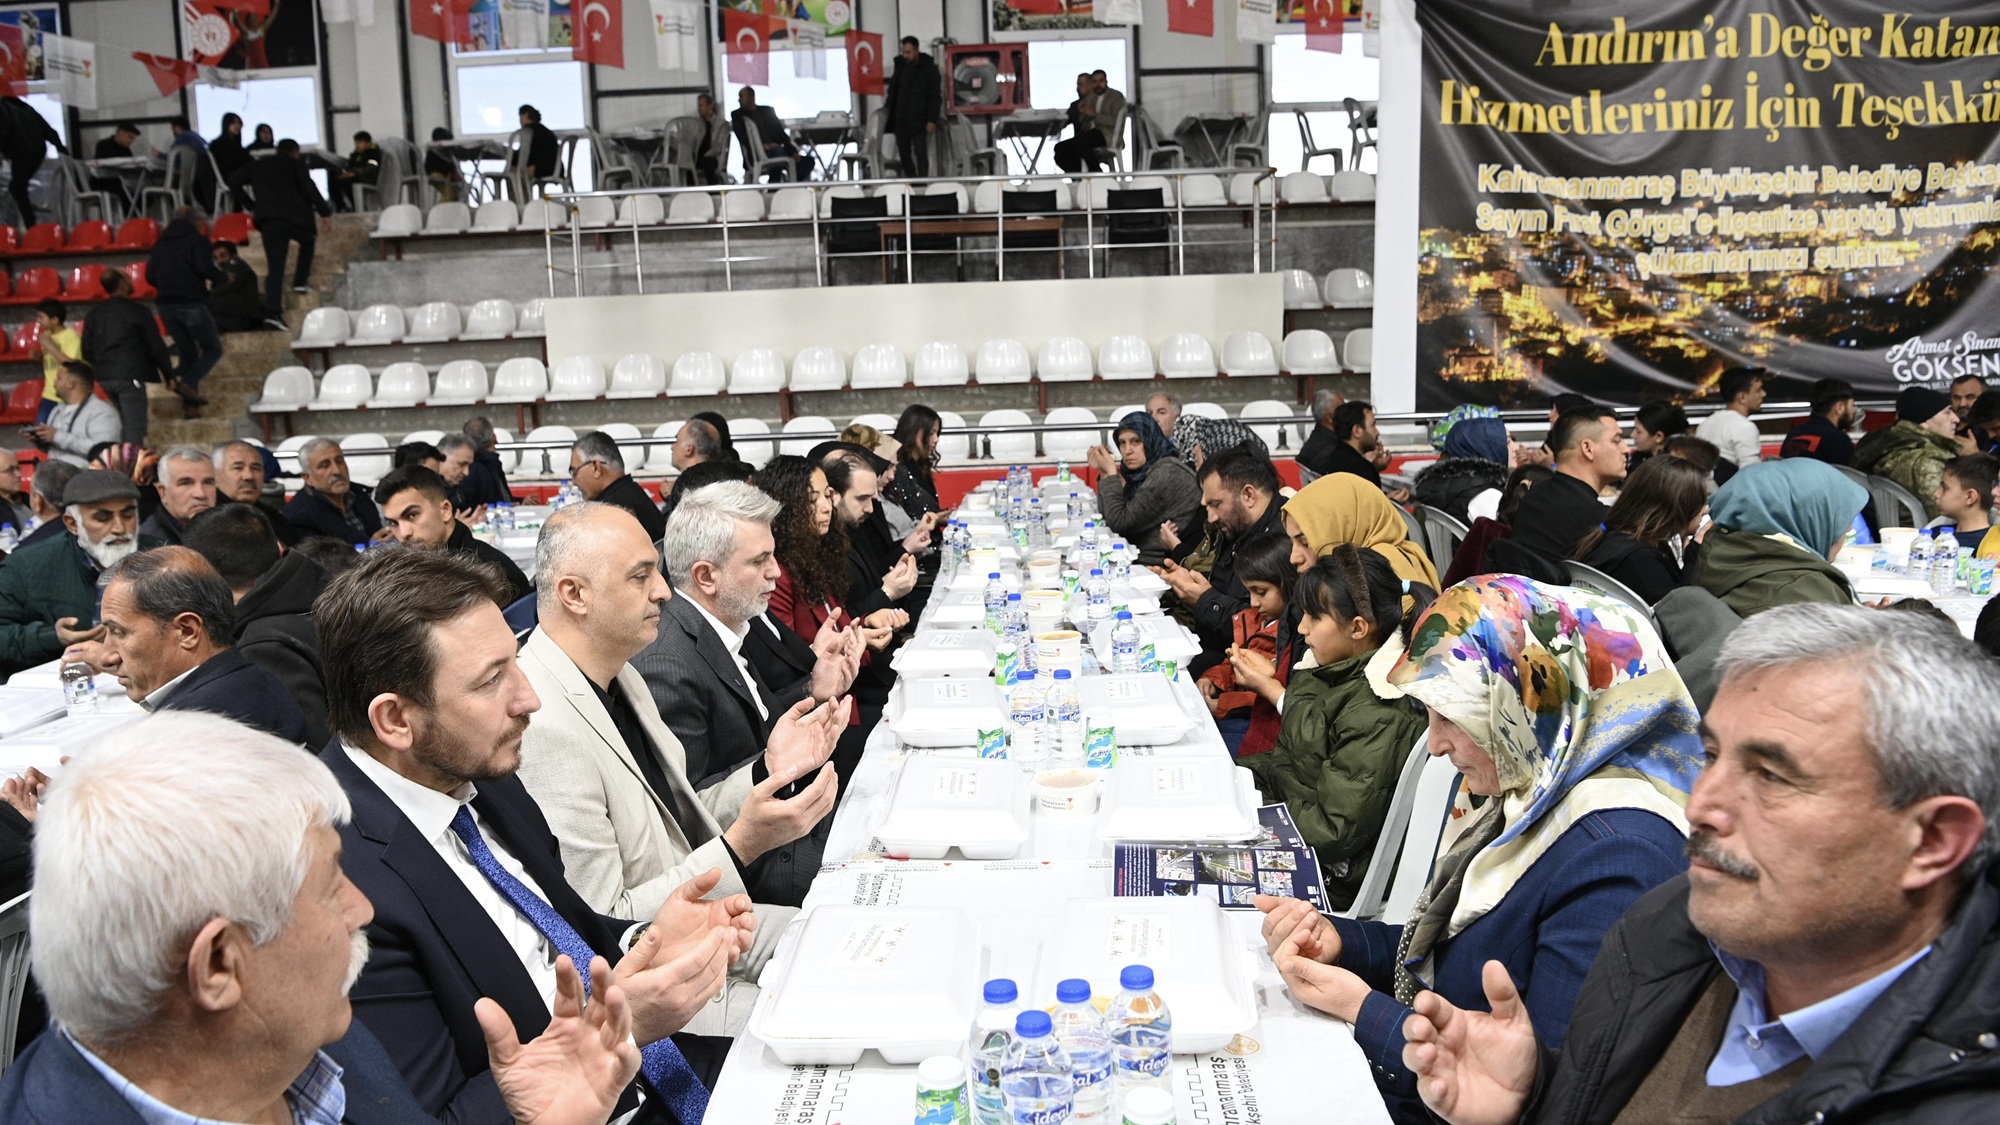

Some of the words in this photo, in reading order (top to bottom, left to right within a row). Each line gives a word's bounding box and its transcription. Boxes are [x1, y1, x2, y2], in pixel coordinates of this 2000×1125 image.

[1534, 14, 1740, 67] Andırın'a
[1748, 12, 1872, 72] Değer
[1878, 13, 2000, 59] Katan
[1439, 79, 1735, 136] Hizmetleriniz
[1744, 71, 1822, 143] İçin
[1832, 79, 2000, 141] Teşekkü
[1478, 163, 1676, 205] Kahramanmaraş
[1680, 165, 1818, 203] Büyükşehir
[1821, 163, 1922, 200] Belediye
[1476, 202, 1548, 239] Sayın
[1605, 206, 1714, 243] Görgel'e
[1717, 204, 1819, 241] ilçemize
[1821, 201, 1897, 237] yaptığı
[1635, 245, 1809, 281] şükranlarımızı
[1813, 245, 1905, 269] sunarız.
[1885, 336, 1952, 363] Ahmet
[1892, 353, 2000, 382] GÖKSEN
[1138, 1050, 1170, 1073] ideal
[1229, 1057, 1254, 1094] Belediyesi
[1033, 1102, 1070, 1125] ideal
[1241, 1095, 1262, 1125] kşehir
